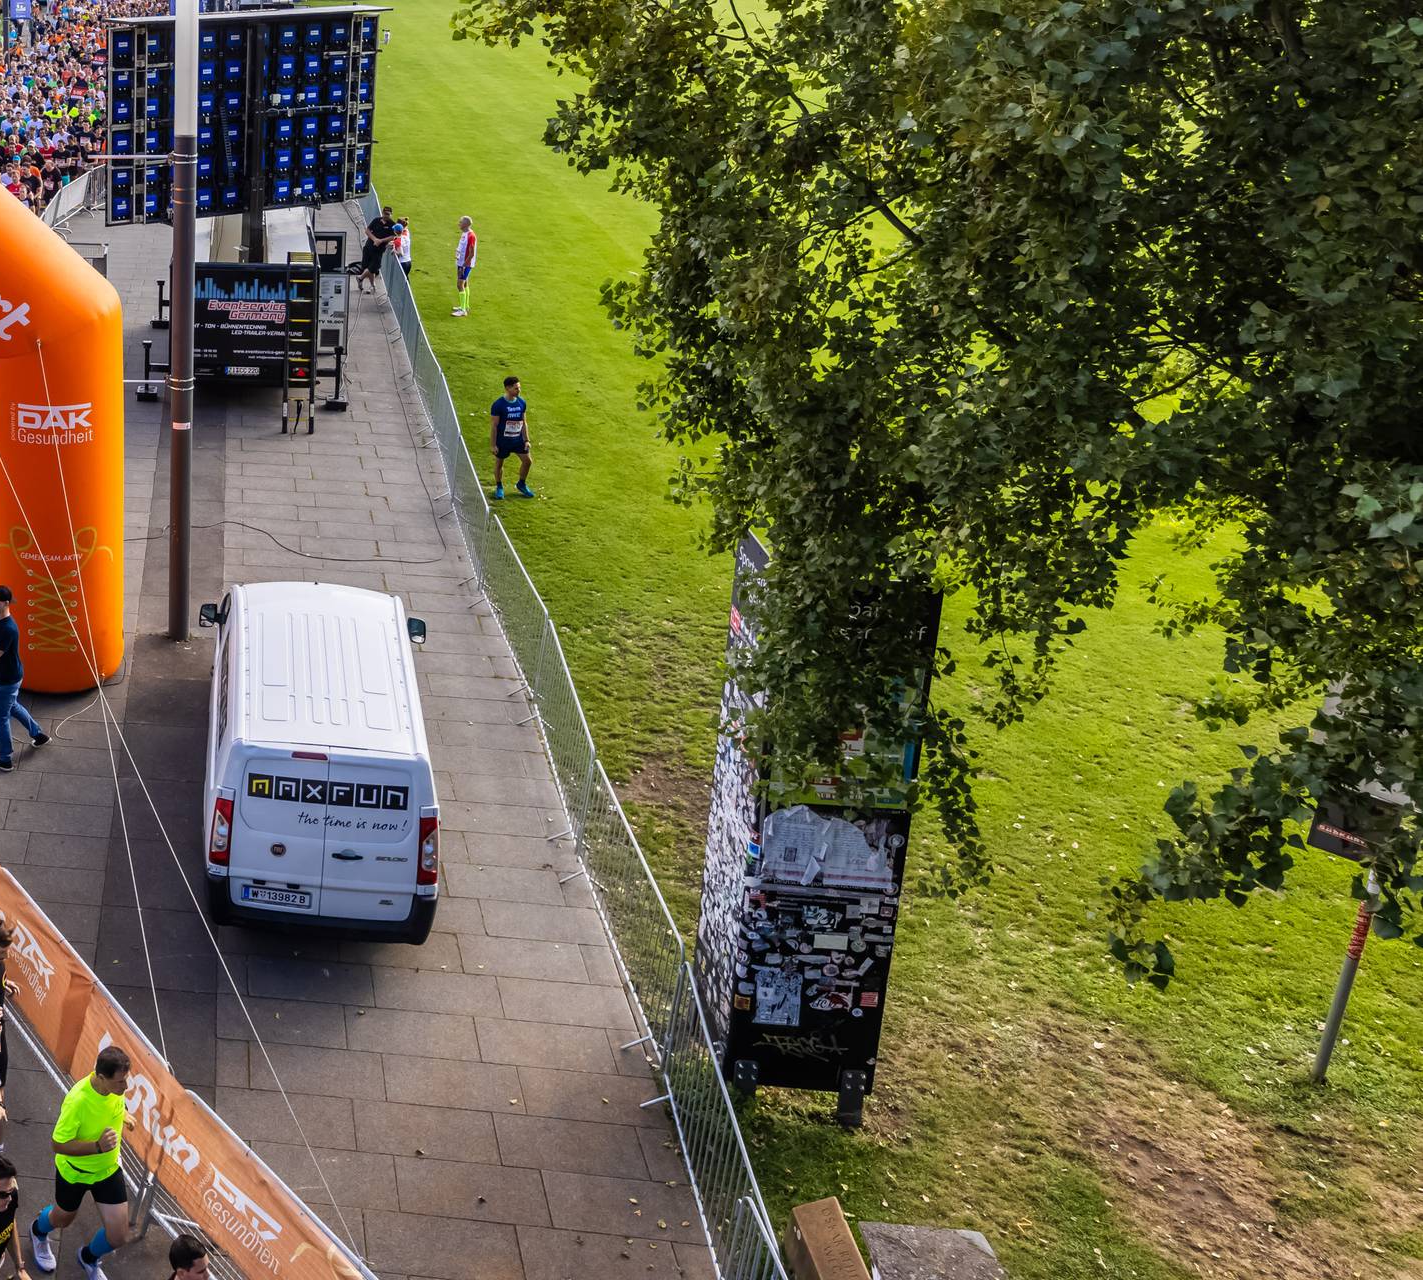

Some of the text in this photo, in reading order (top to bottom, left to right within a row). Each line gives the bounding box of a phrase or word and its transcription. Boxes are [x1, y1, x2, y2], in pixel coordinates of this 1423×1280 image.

[207, 300, 287, 311] Eventservice
[229, 310, 287, 324] Germany
[18, 402, 92, 430] DAK
[17, 429, 94, 445] Gesundheit
[251, 777, 405, 809] MAXFUN
[297, 811, 319, 825] the
[323, 814, 352, 829] time
[356, 817, 367, 829] is
[251, 889, 260, 898] W
